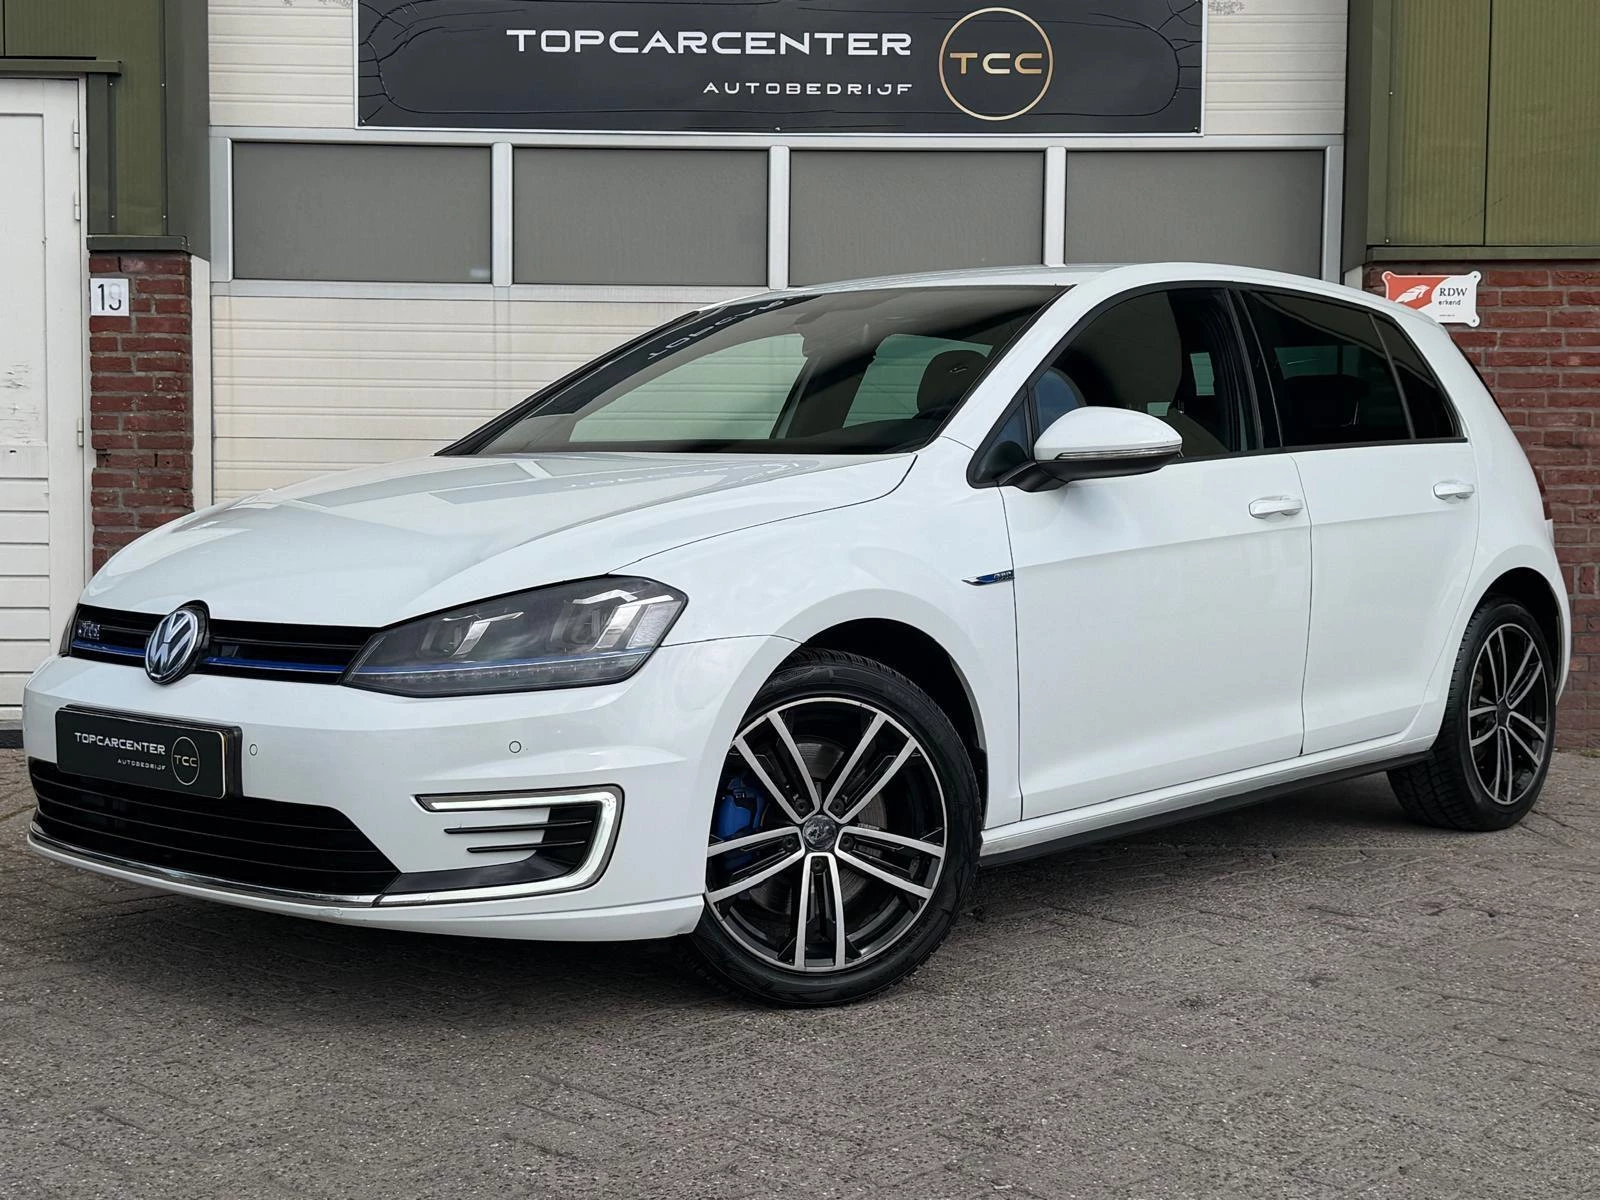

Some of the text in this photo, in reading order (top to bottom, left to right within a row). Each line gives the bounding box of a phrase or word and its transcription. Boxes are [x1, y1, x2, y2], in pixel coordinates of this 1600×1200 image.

[506, 29, 912, 56] TOPCARCENTER
[949, 53, 1042, 74] TCC
[703, 82, 912, 96] AUTOBEDRIJF
[1439, 287, 1468, 297] RDW
[74, 732, 166, 755] TOPCARCENTER
[117, 758, 166, 770] AUTOBEDRIJF
[173, 754, 198, 767] TCC
